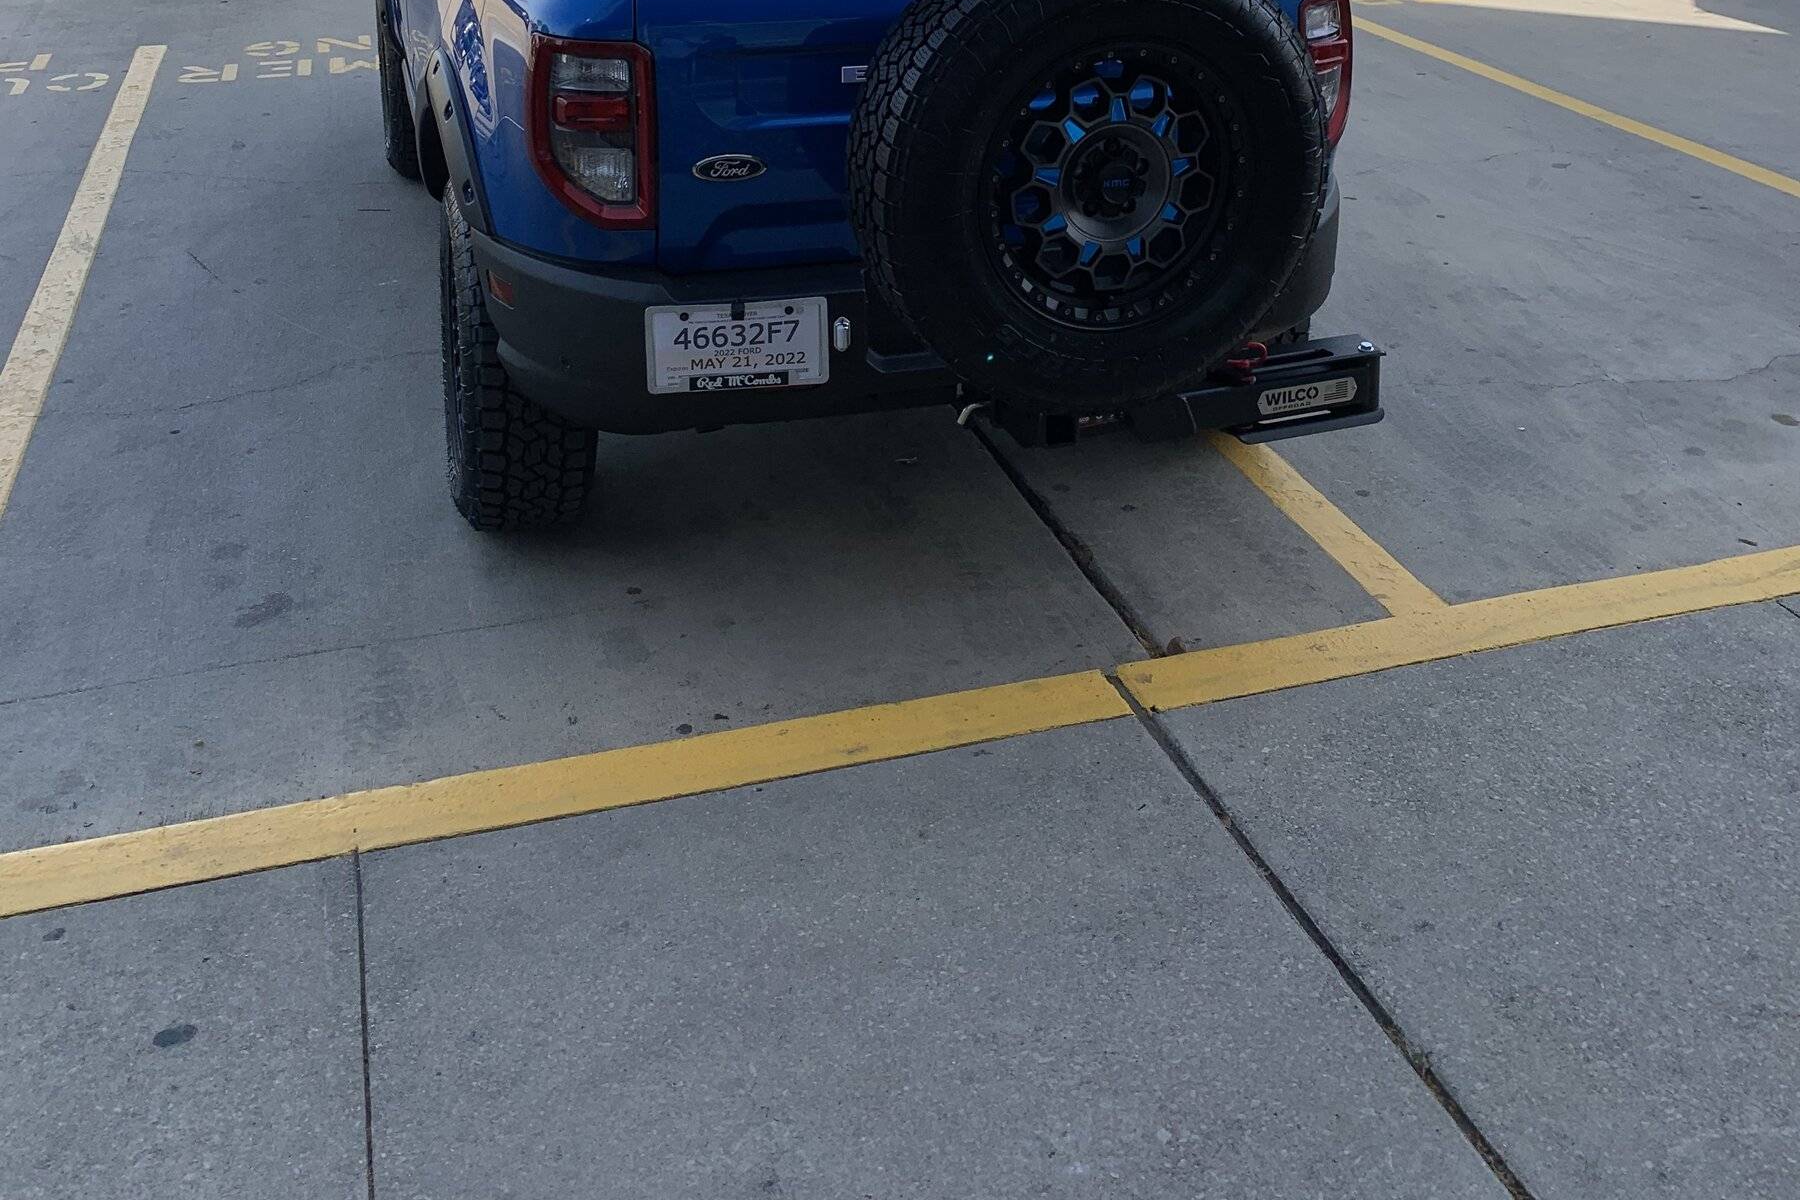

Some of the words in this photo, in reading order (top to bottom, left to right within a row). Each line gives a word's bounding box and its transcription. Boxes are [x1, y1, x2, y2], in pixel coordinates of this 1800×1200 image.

[710, 160, 750, 177] Ford
[673, 320, 800, 350] 46632F7
[713, 349, 735, 357] 2022
[737, 346, 762, 355] FORD
[690, 356, 726, 371] MAY
[732, 355, 758, 369] 21,
[765, 351, 807, 366] 2022
[696, 375, 723, 390] Red
[723, 373, 782, 388] McCombs
[1265, 386, 1319, 406] WILCO
